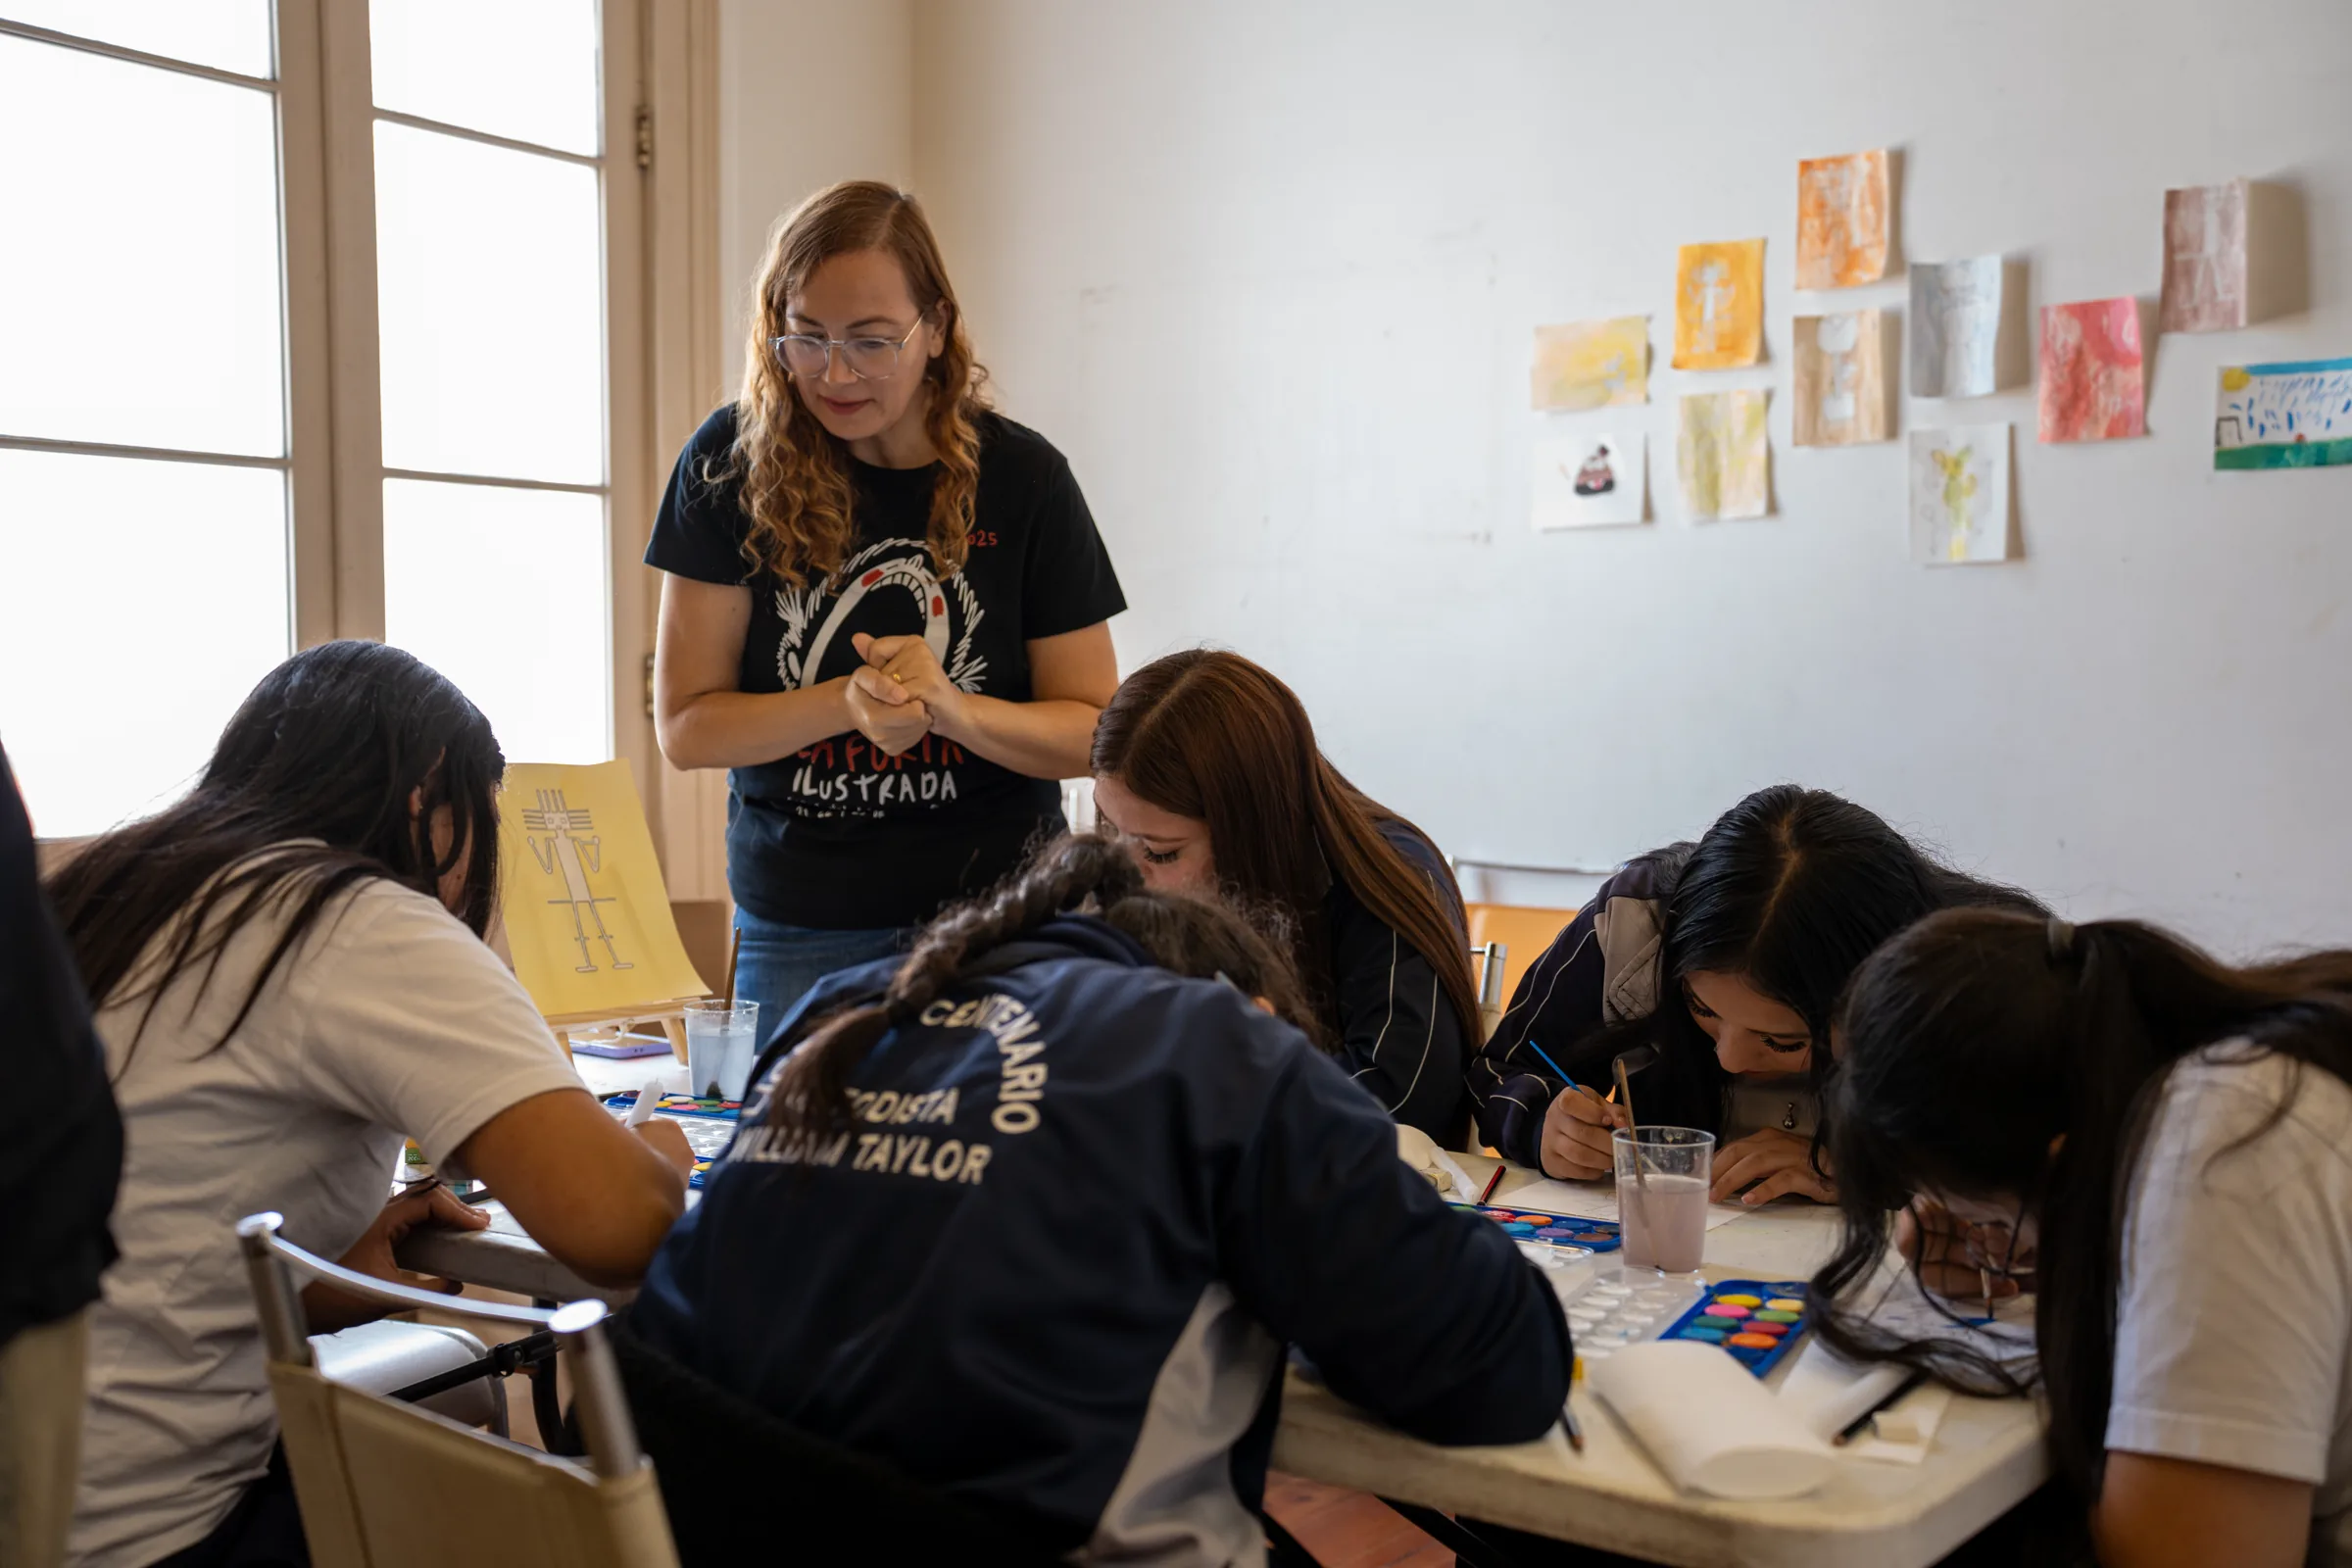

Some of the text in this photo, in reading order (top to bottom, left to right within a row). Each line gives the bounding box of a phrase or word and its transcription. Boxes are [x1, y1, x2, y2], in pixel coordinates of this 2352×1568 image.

[964, 529, 998, 547] 025
[792, 763, 957, 806] ILUSTRADA
[852, 1133, 993, 1185] TAYLOR
